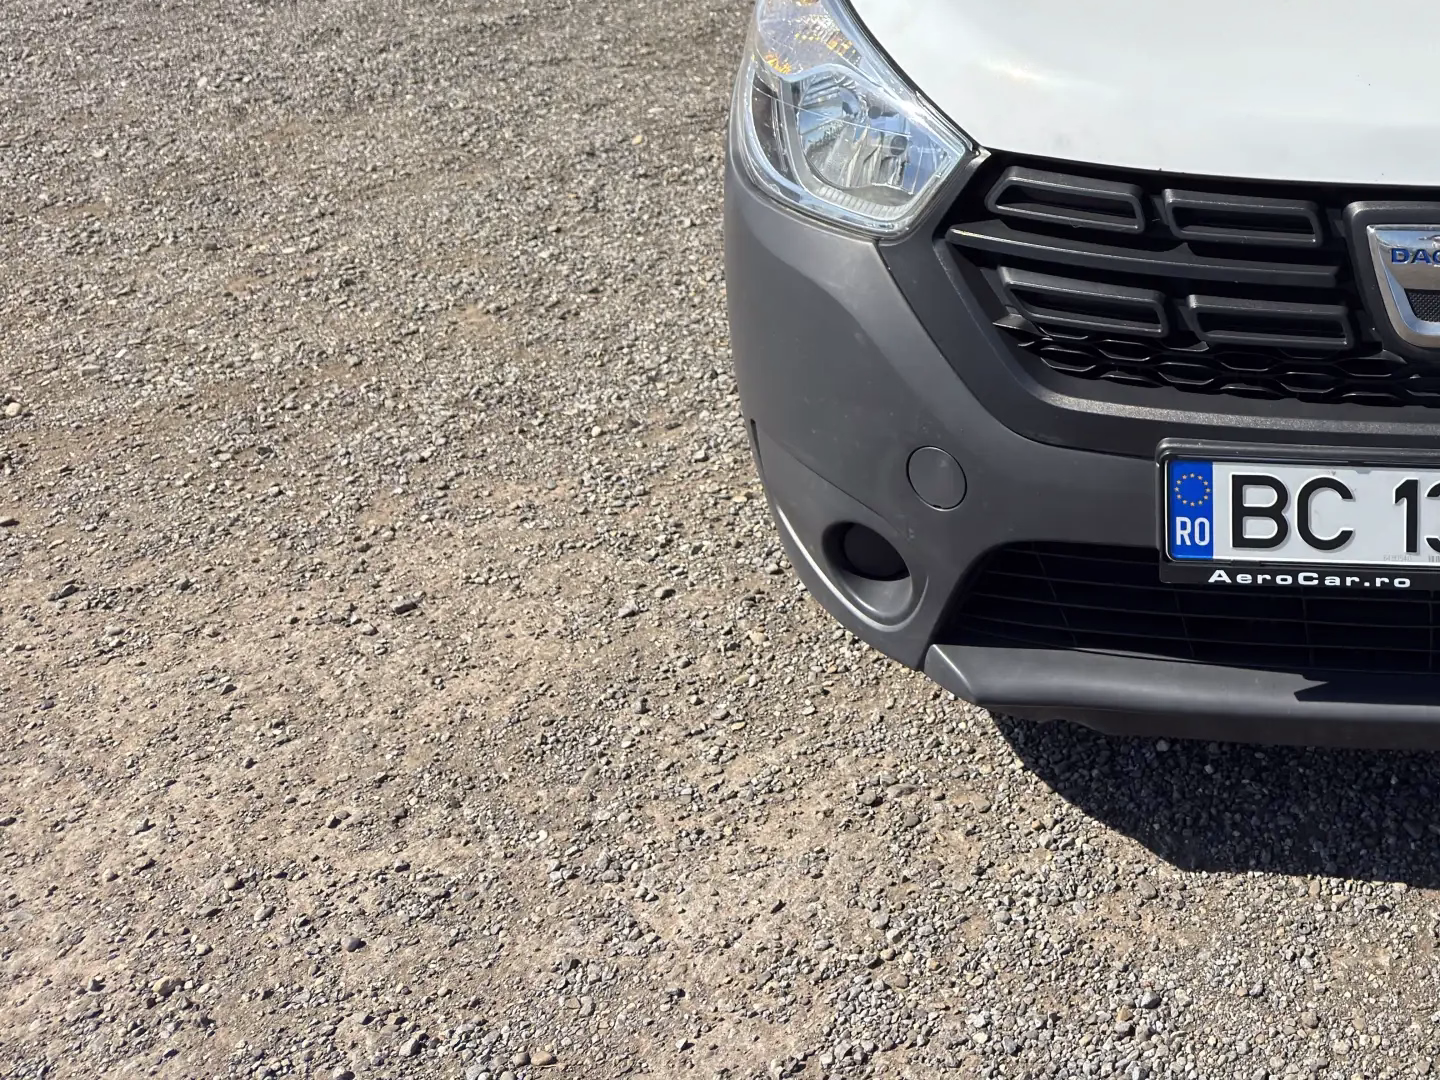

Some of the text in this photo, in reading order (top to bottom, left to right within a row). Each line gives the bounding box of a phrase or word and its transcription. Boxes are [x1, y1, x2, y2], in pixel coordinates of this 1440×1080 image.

[1231, 473, 1355, 552] BC
[1175, 516, 1211, 547] RO
[1208, 569, 1411, 589] AeroCar.ro
